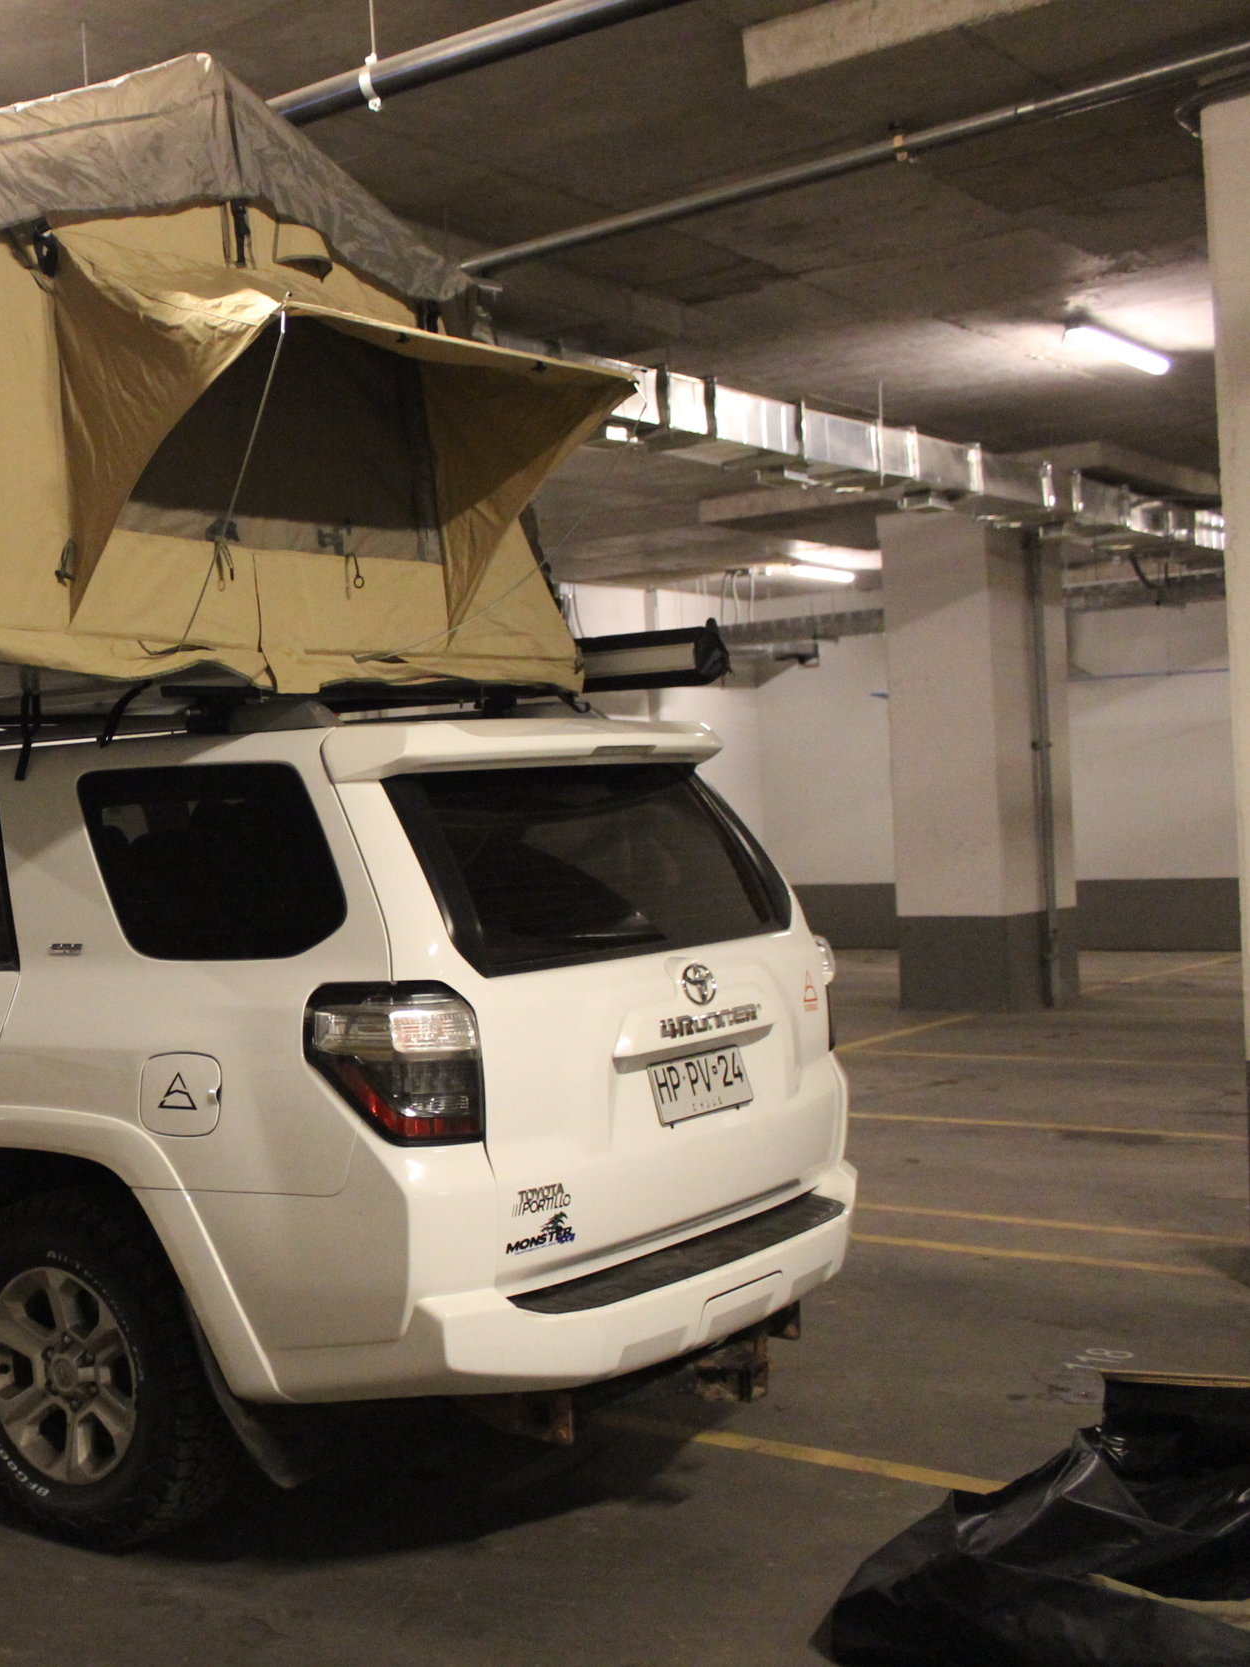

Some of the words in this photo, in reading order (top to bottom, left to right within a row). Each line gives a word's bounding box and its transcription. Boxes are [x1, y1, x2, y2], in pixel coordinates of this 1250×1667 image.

[518, 1183, 564, 1204] TOYOTA
[522, 1194, 571, 1215] PORTILLO
[506, 1227, 572, 1254] MONSTER
